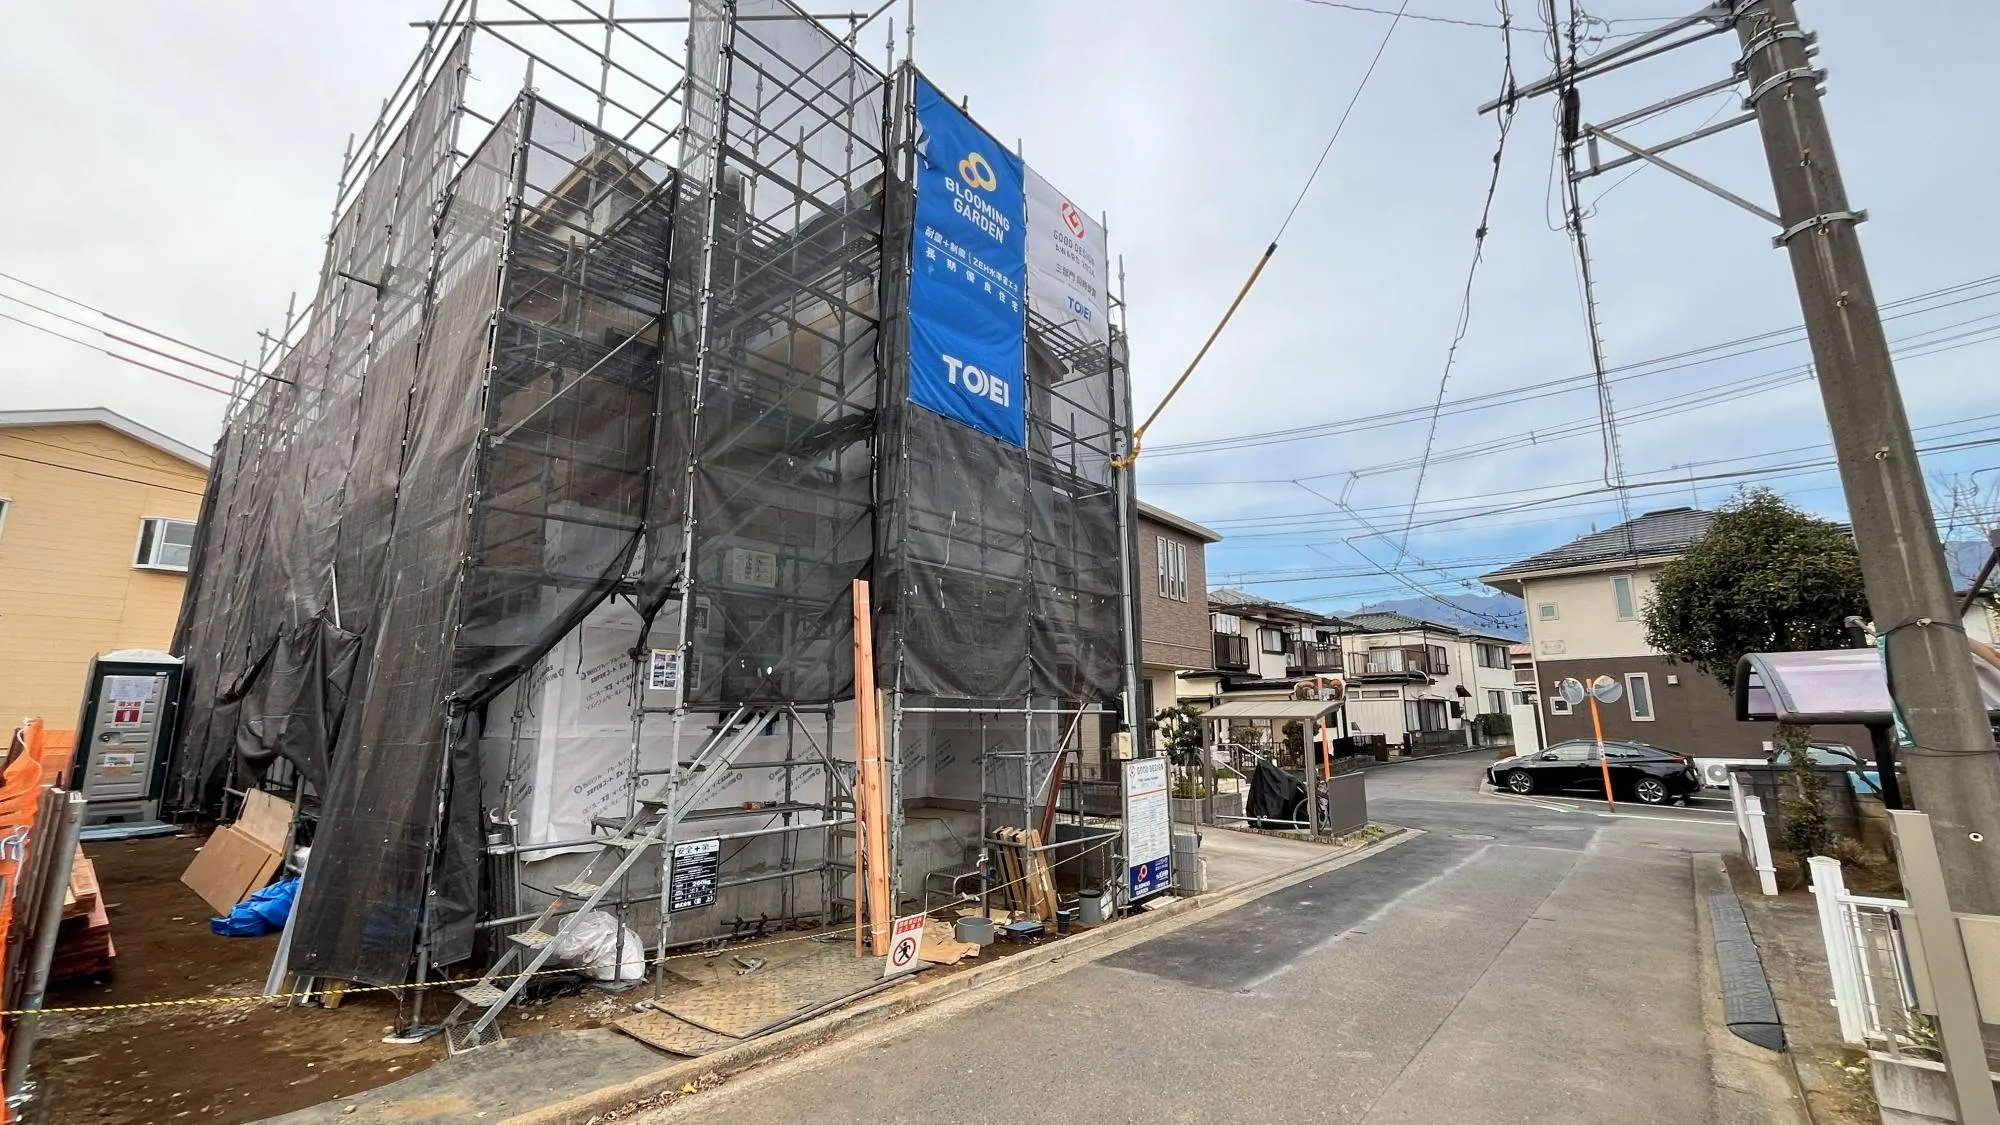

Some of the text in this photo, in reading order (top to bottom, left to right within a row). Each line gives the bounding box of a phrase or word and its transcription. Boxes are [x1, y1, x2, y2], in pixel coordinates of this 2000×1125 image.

[945, 177, 1010, 232] BLOOMING
[954, 198, 1004, 244] GARDEN
[1053, 229, 1095, 267] GOOD DESIGN
[1055, 243, 1080, 265] AWARD
[926, 247, 1019, 313] 長期優良住宅
[942, 354, 1009, 408] TOEI
[1137, 763, 1164, 775] GOOD DESIGN
